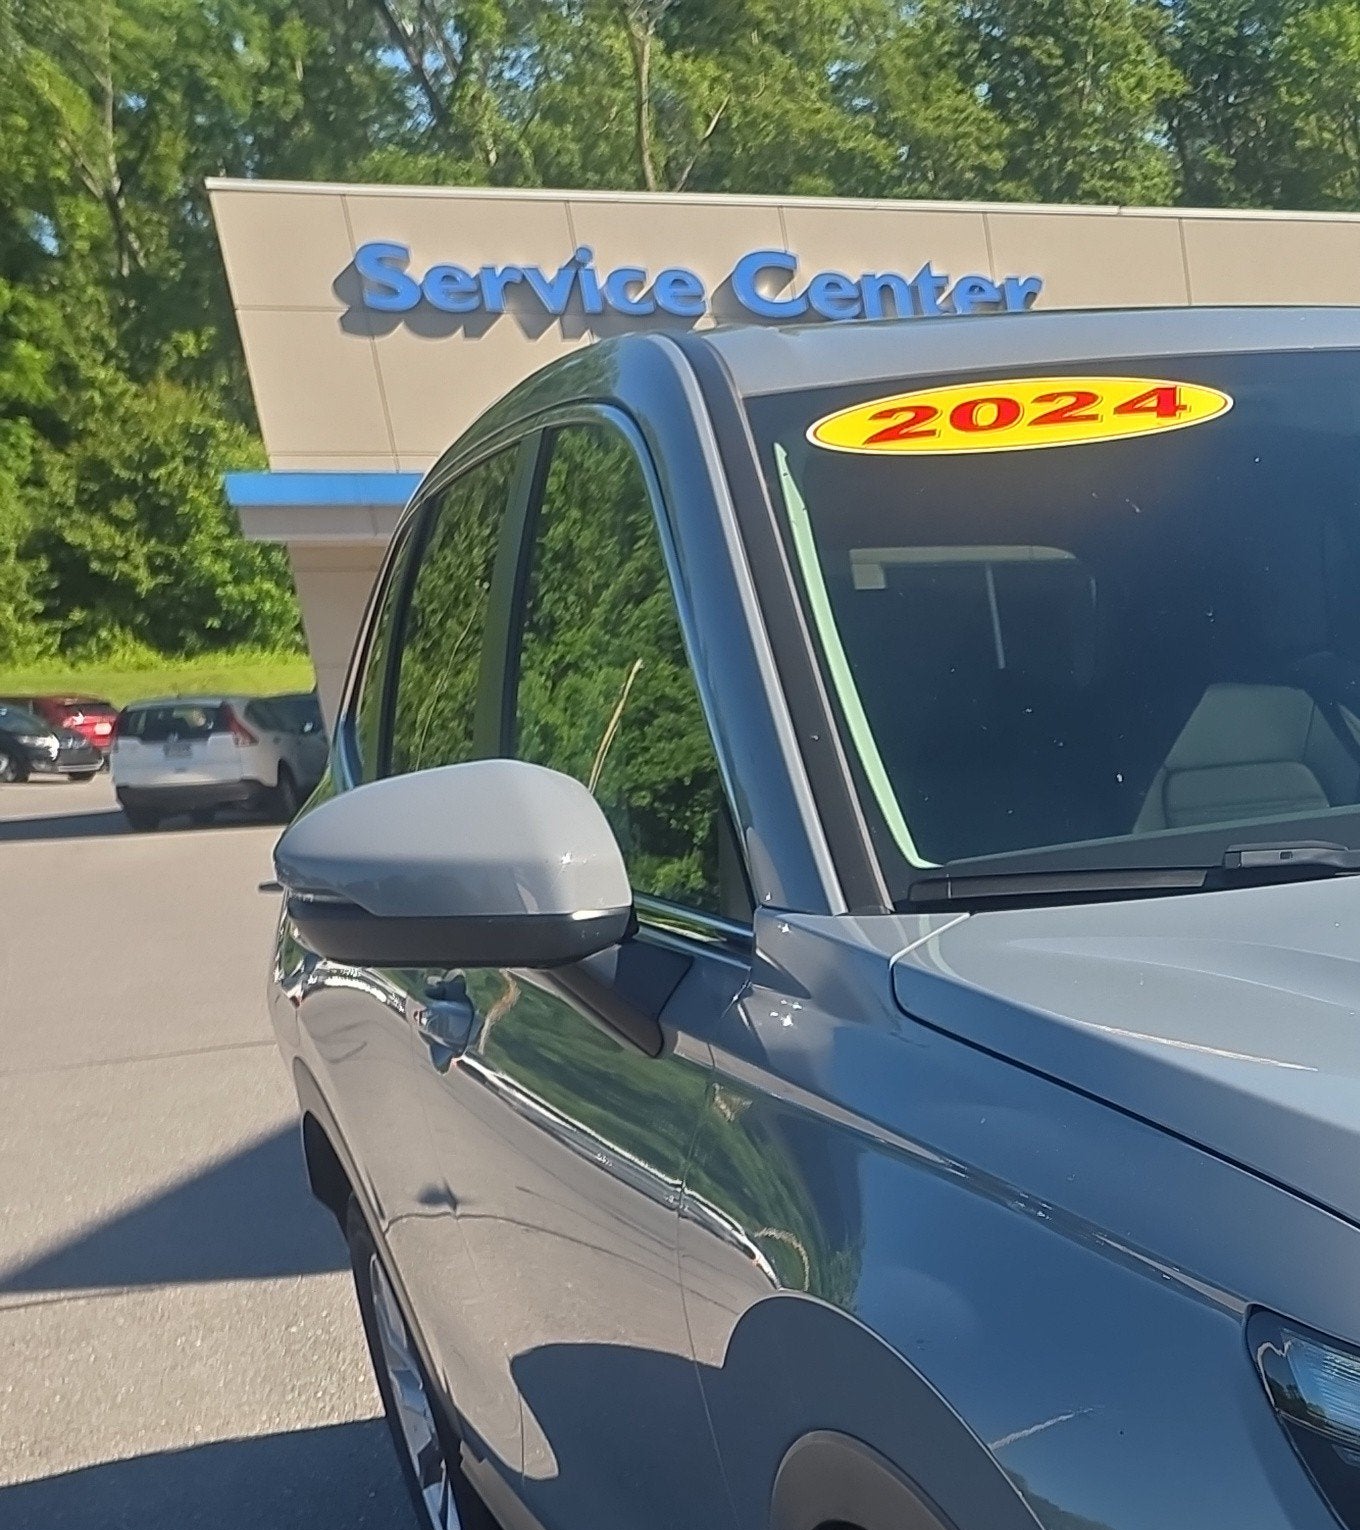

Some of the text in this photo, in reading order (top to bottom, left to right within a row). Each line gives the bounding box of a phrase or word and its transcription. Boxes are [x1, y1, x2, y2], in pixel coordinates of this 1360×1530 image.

[355, 242, 1043, 321] Service Center
[864, 385, 1188, 446] 2024
